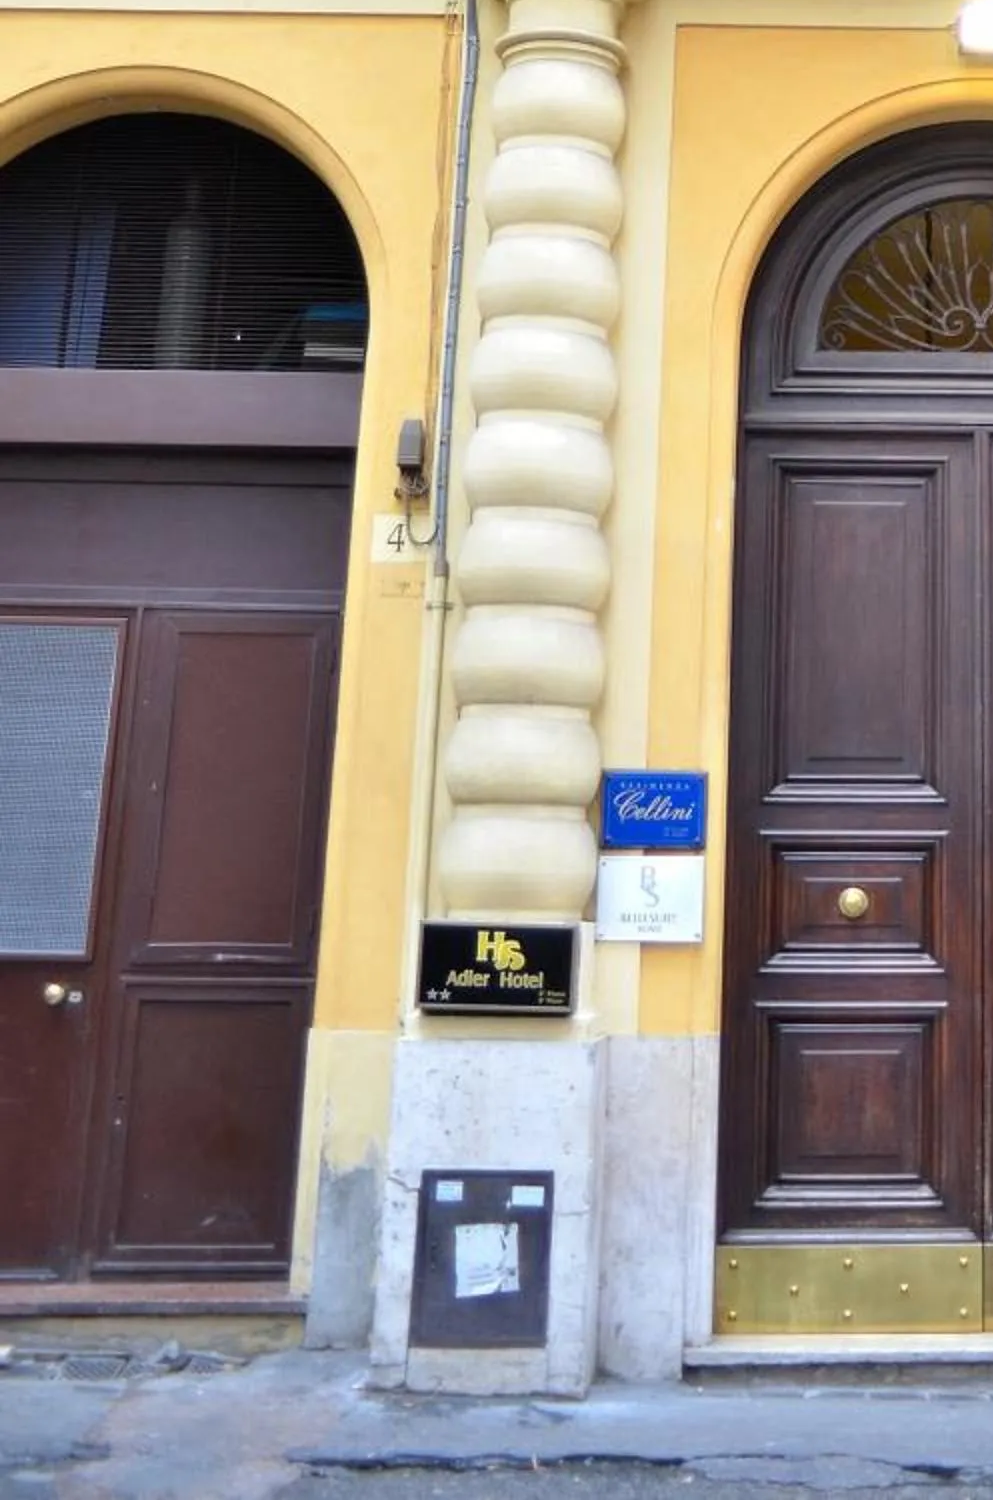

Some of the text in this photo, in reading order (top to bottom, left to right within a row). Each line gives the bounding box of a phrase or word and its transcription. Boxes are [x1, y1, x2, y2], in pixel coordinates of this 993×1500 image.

[386, 523, 405, 552] 4
[613, 790, 695, 823] Cellini
[445, 970, 544, 988] Adler Hotel
